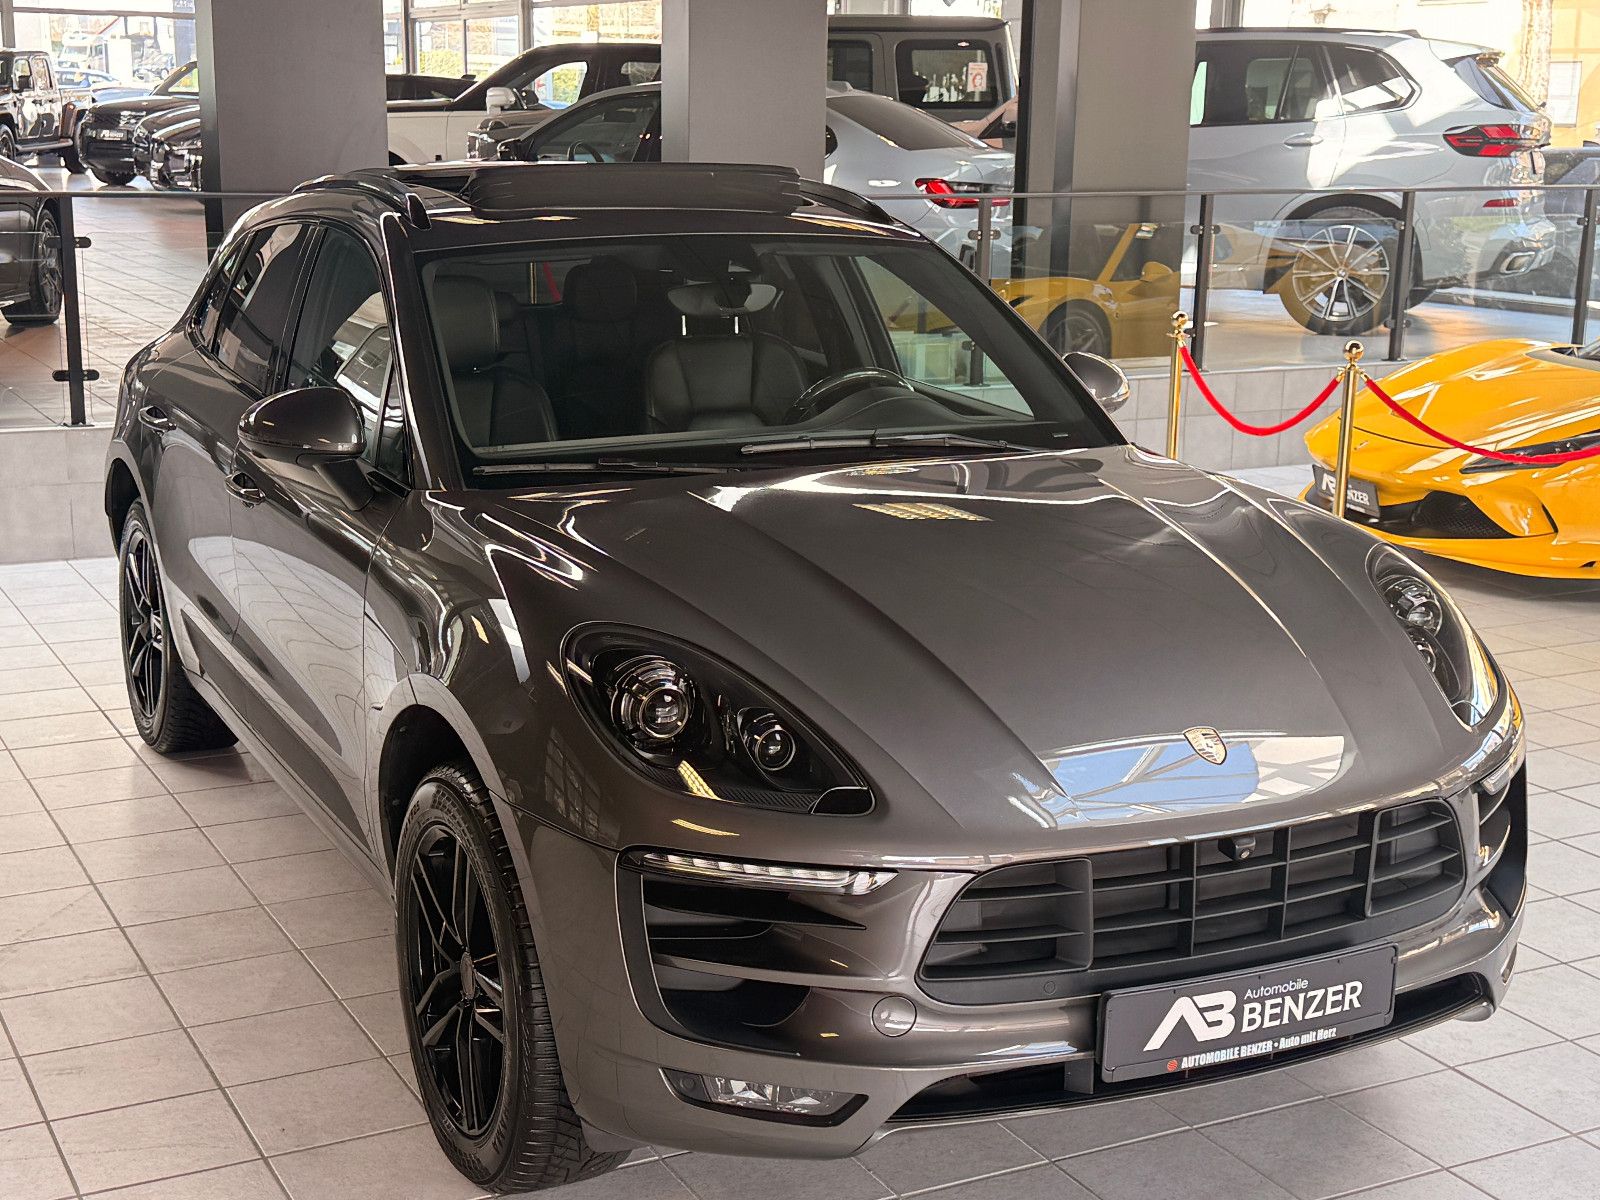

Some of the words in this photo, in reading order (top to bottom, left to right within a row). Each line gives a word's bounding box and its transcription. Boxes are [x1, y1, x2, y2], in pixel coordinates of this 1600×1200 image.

[1241, 980, 1363, 1033] BENZER
[1243, 978, 1309, 1000] Automobile
[1181, 1046, 1240, 1069] AUTOMOBILE
[1240, 1040, 1273, 1058] BENZER
[1279, 1036, 1300, 1050] Auto
[1300, 1031, 1317, 1044] mit
[1316, 1027, 1337, 1041] Herz
